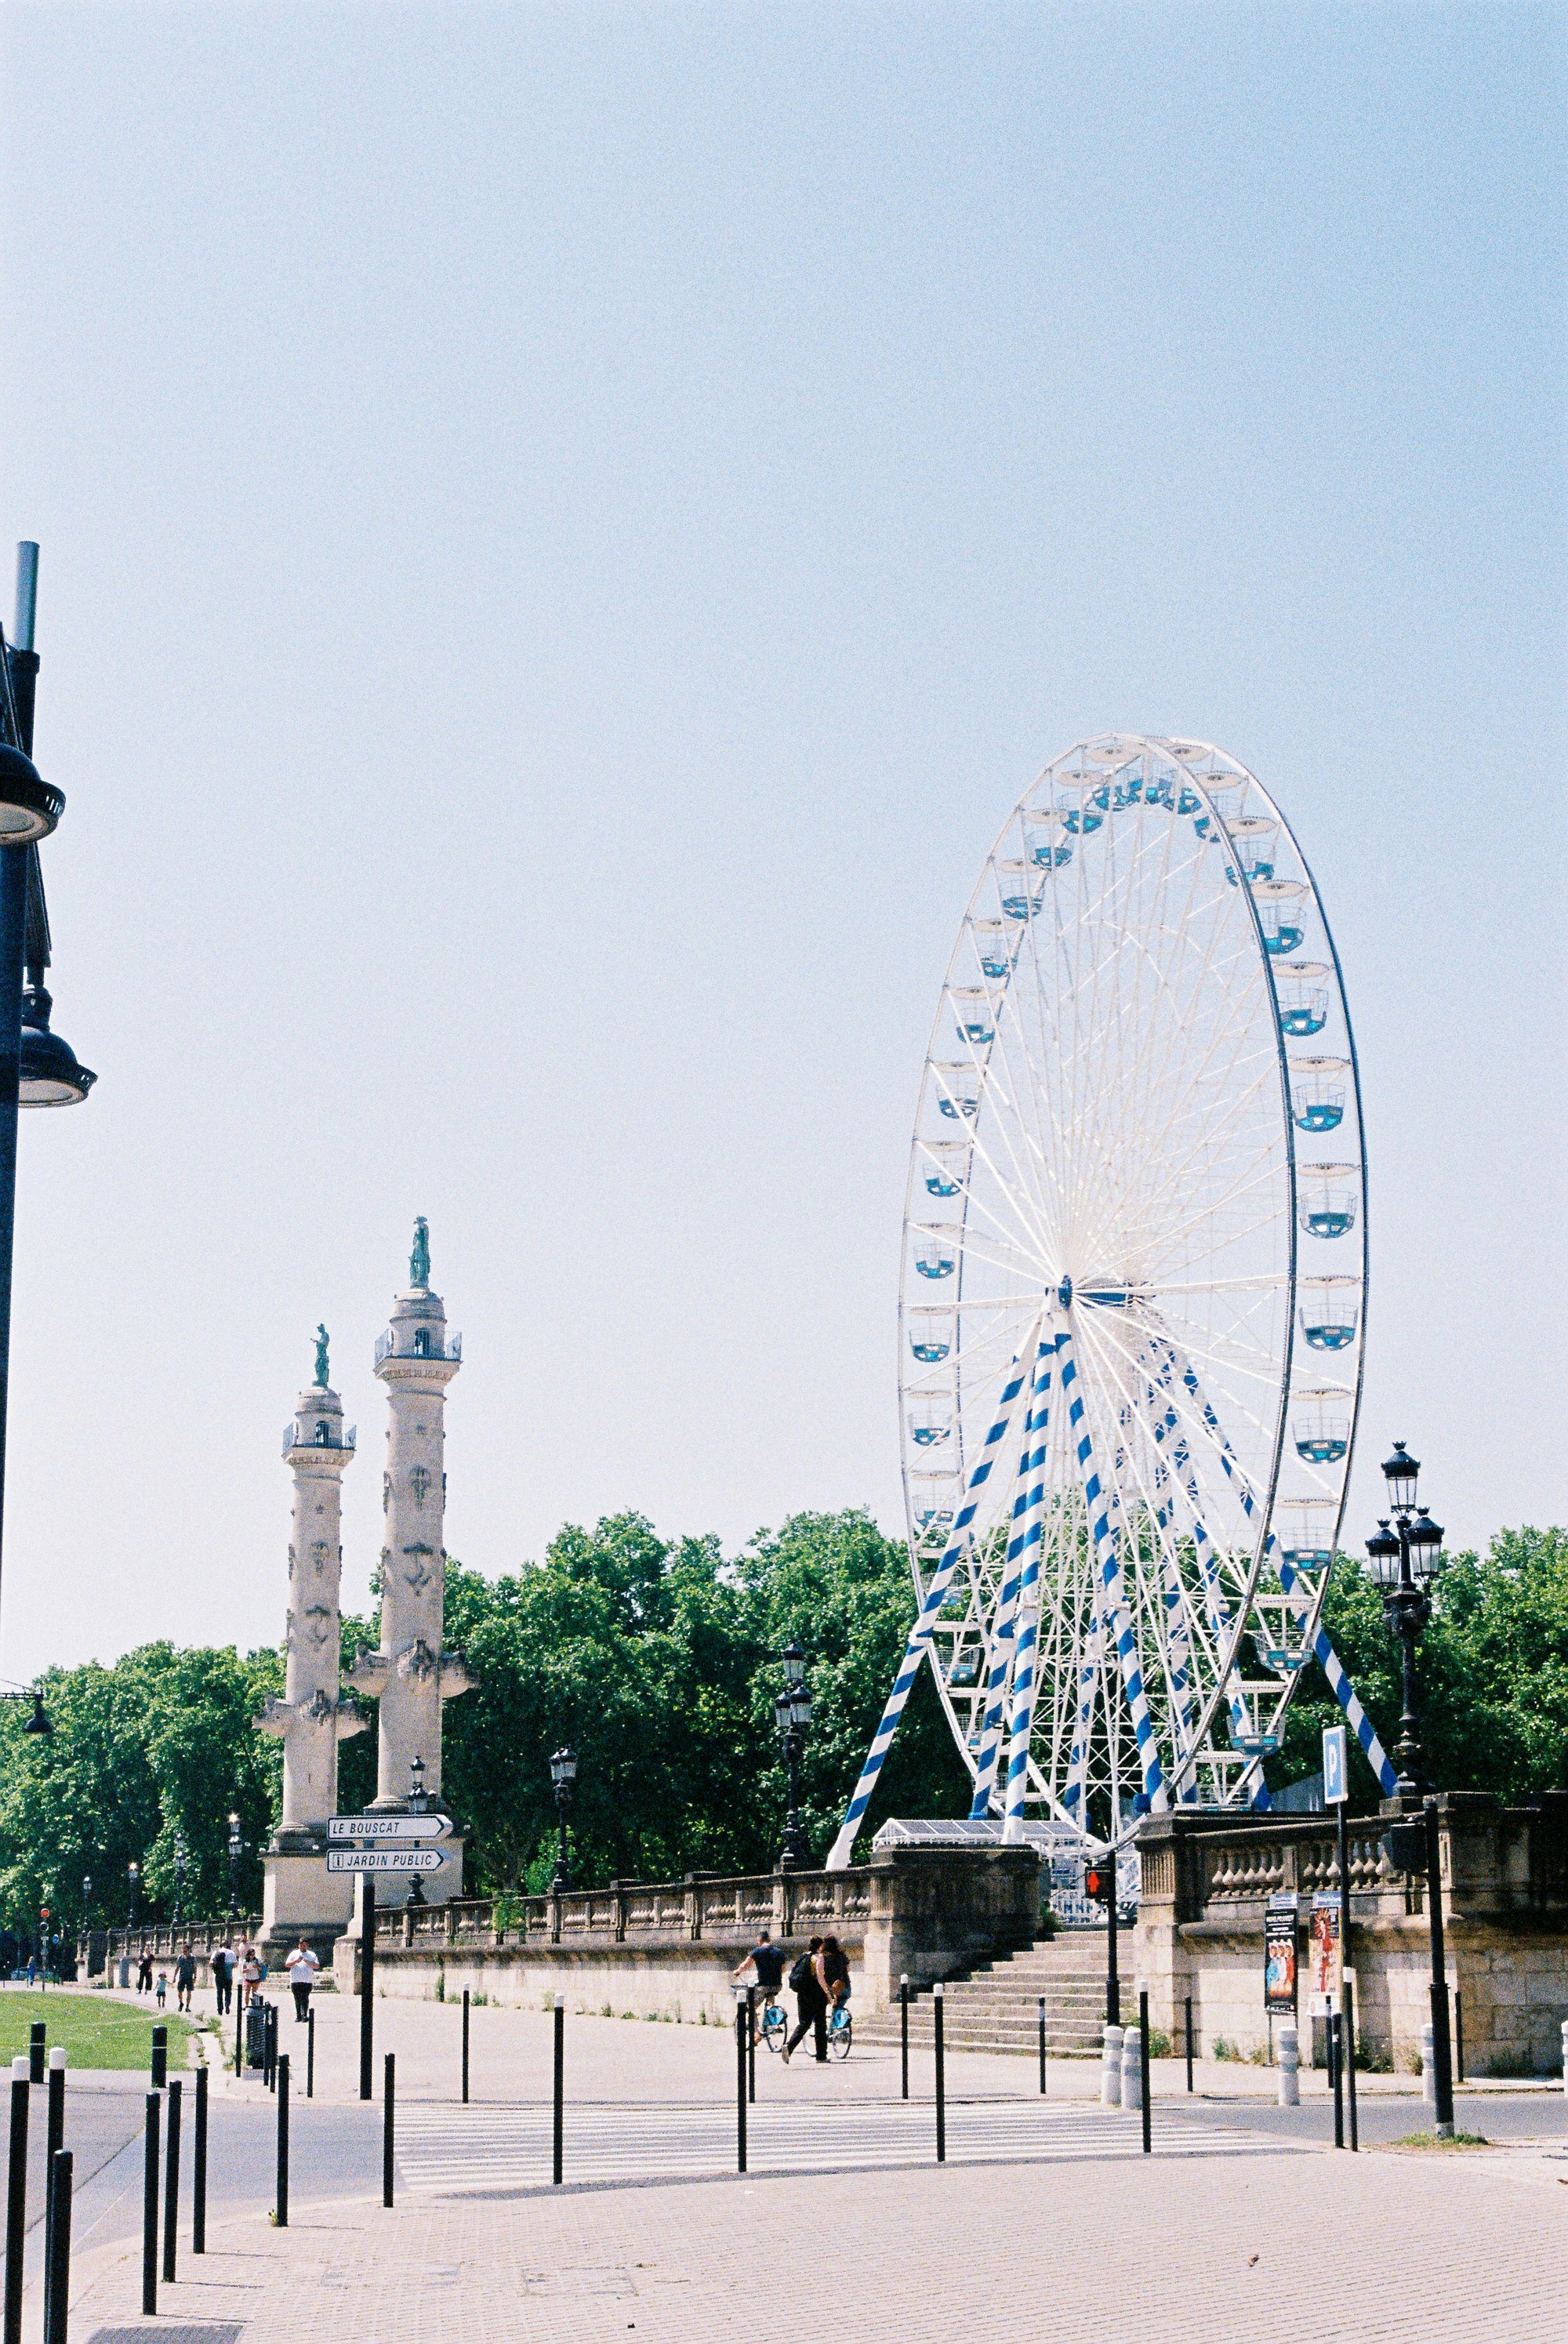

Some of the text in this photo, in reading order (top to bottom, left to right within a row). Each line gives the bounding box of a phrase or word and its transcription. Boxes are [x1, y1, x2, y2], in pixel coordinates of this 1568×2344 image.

[1329, 1744, 1337, 1787] P
[333, 1822, 400, 1834] LE BOUSCAT
[347, 1855, 388, 1866] JARDIN
[393, 1855, 432, 1866] PUBLIC
